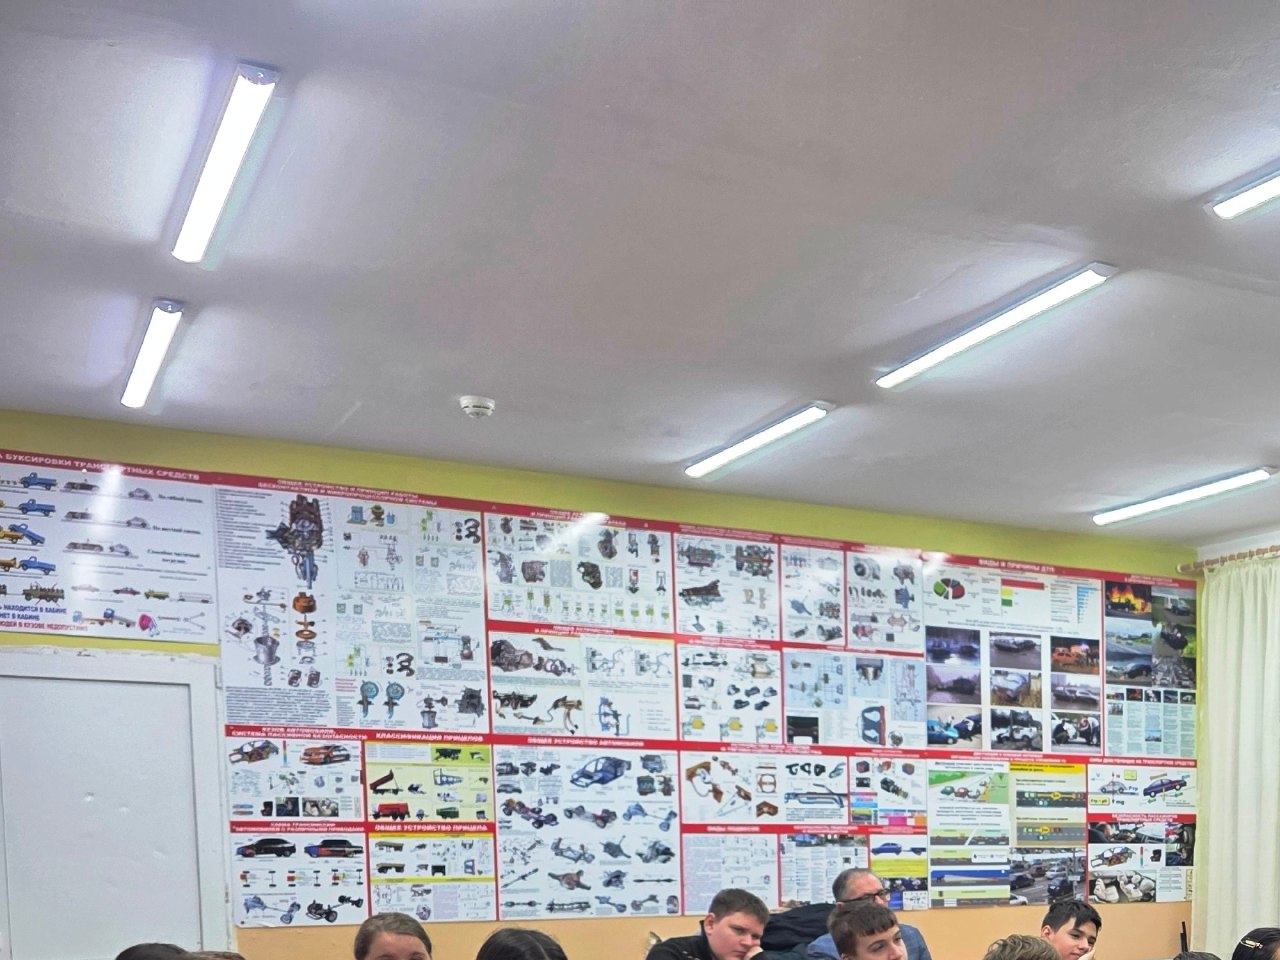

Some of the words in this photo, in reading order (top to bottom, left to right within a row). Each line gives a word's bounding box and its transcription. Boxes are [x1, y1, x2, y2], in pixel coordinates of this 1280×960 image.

[5, 453, 72, 466] БУКСИРОВКИ
[156, 469, 200, 480] СРЕДСТВ
[978, 558, 999, 567] ВИДЫ
[1007, 561, 1040, 571] ПРИЧИНЫ
